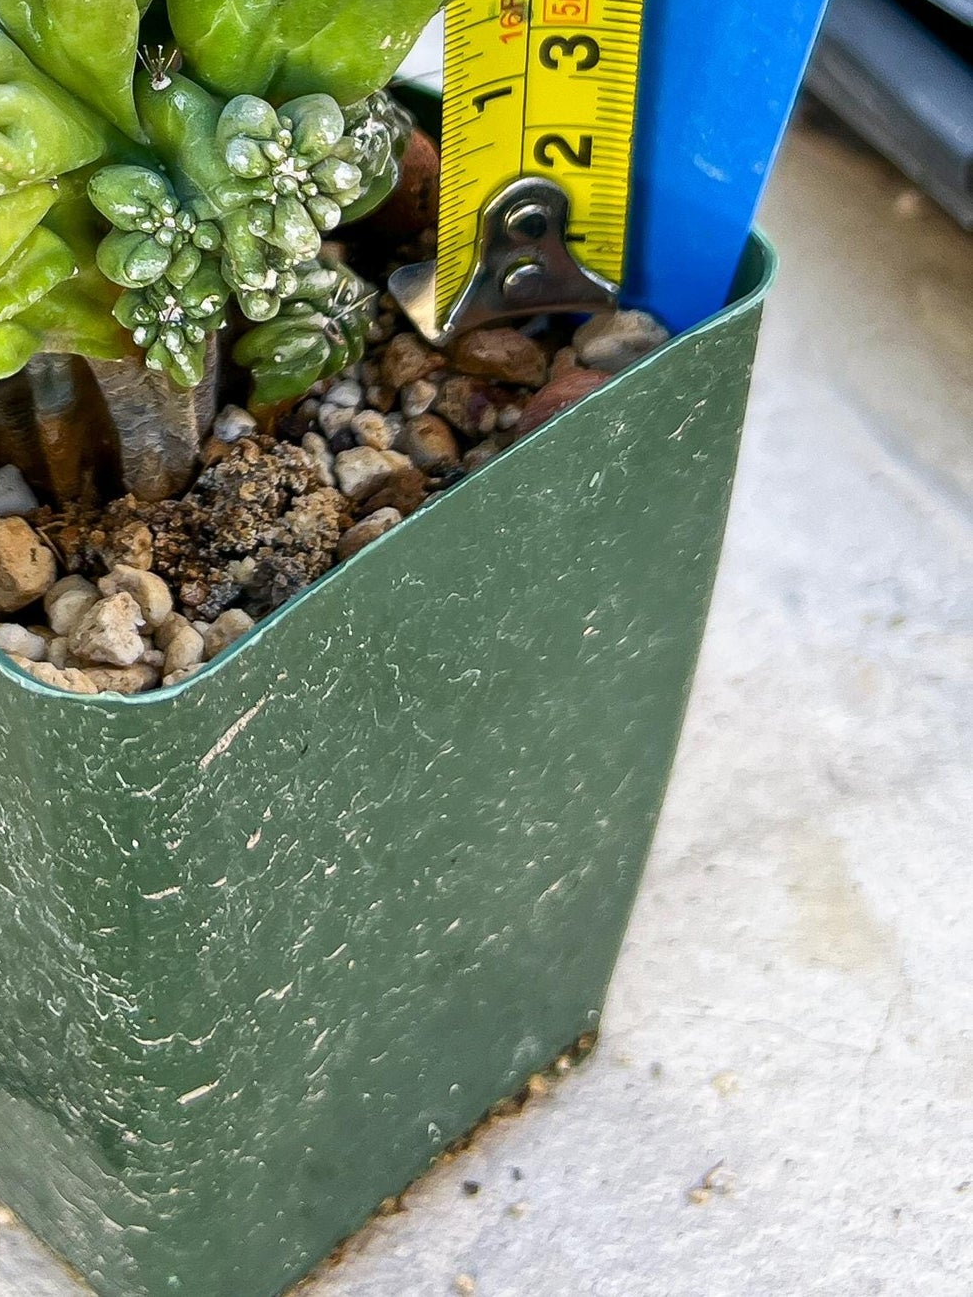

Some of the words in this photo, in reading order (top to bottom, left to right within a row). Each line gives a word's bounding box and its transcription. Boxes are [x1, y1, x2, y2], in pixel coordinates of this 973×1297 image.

[539, 34, 600, 71] 3
[472, 86, 512, 112] 1
[534, 134, 592, 168] 2
